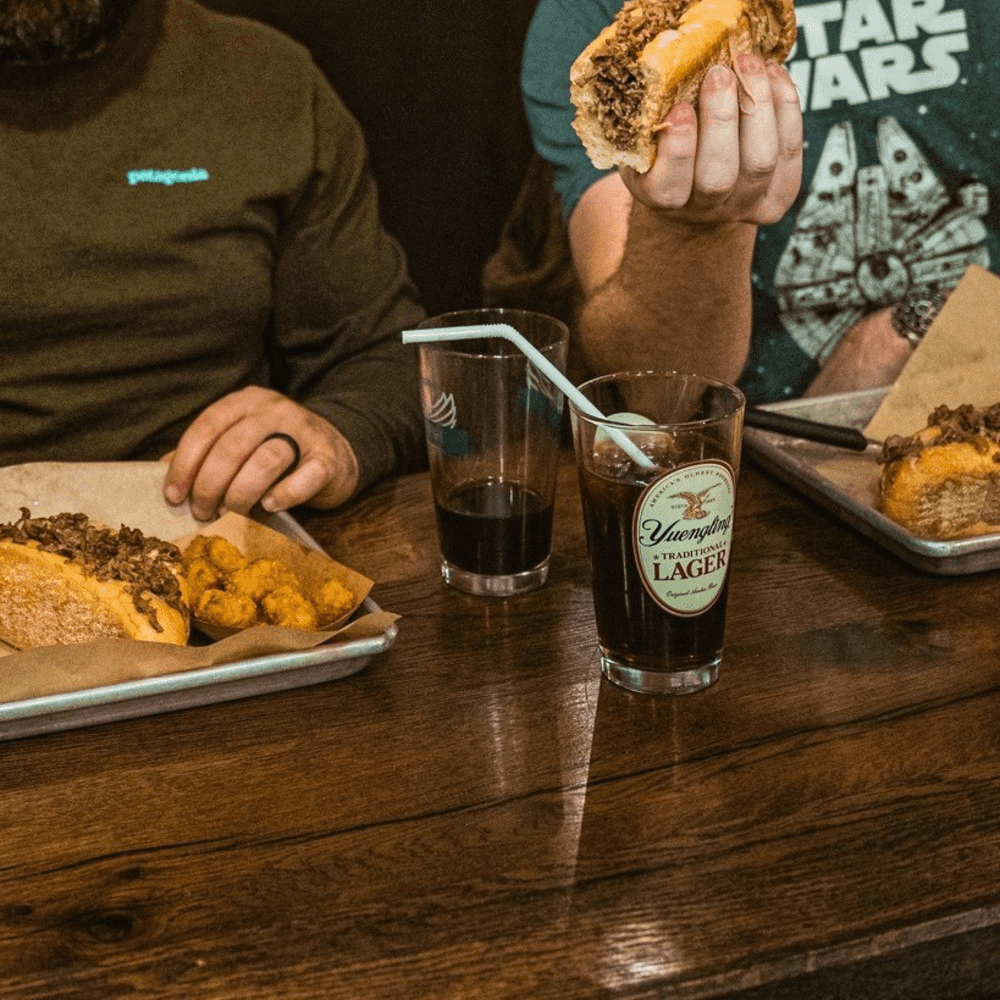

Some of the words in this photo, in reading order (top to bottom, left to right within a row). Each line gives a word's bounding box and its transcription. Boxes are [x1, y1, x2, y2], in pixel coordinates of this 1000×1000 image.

[639, 514, 732, 547] Yuengling
[653, 549, 727, 581] LAGER
[661, 541, 723, 560] TRADITIONAL
